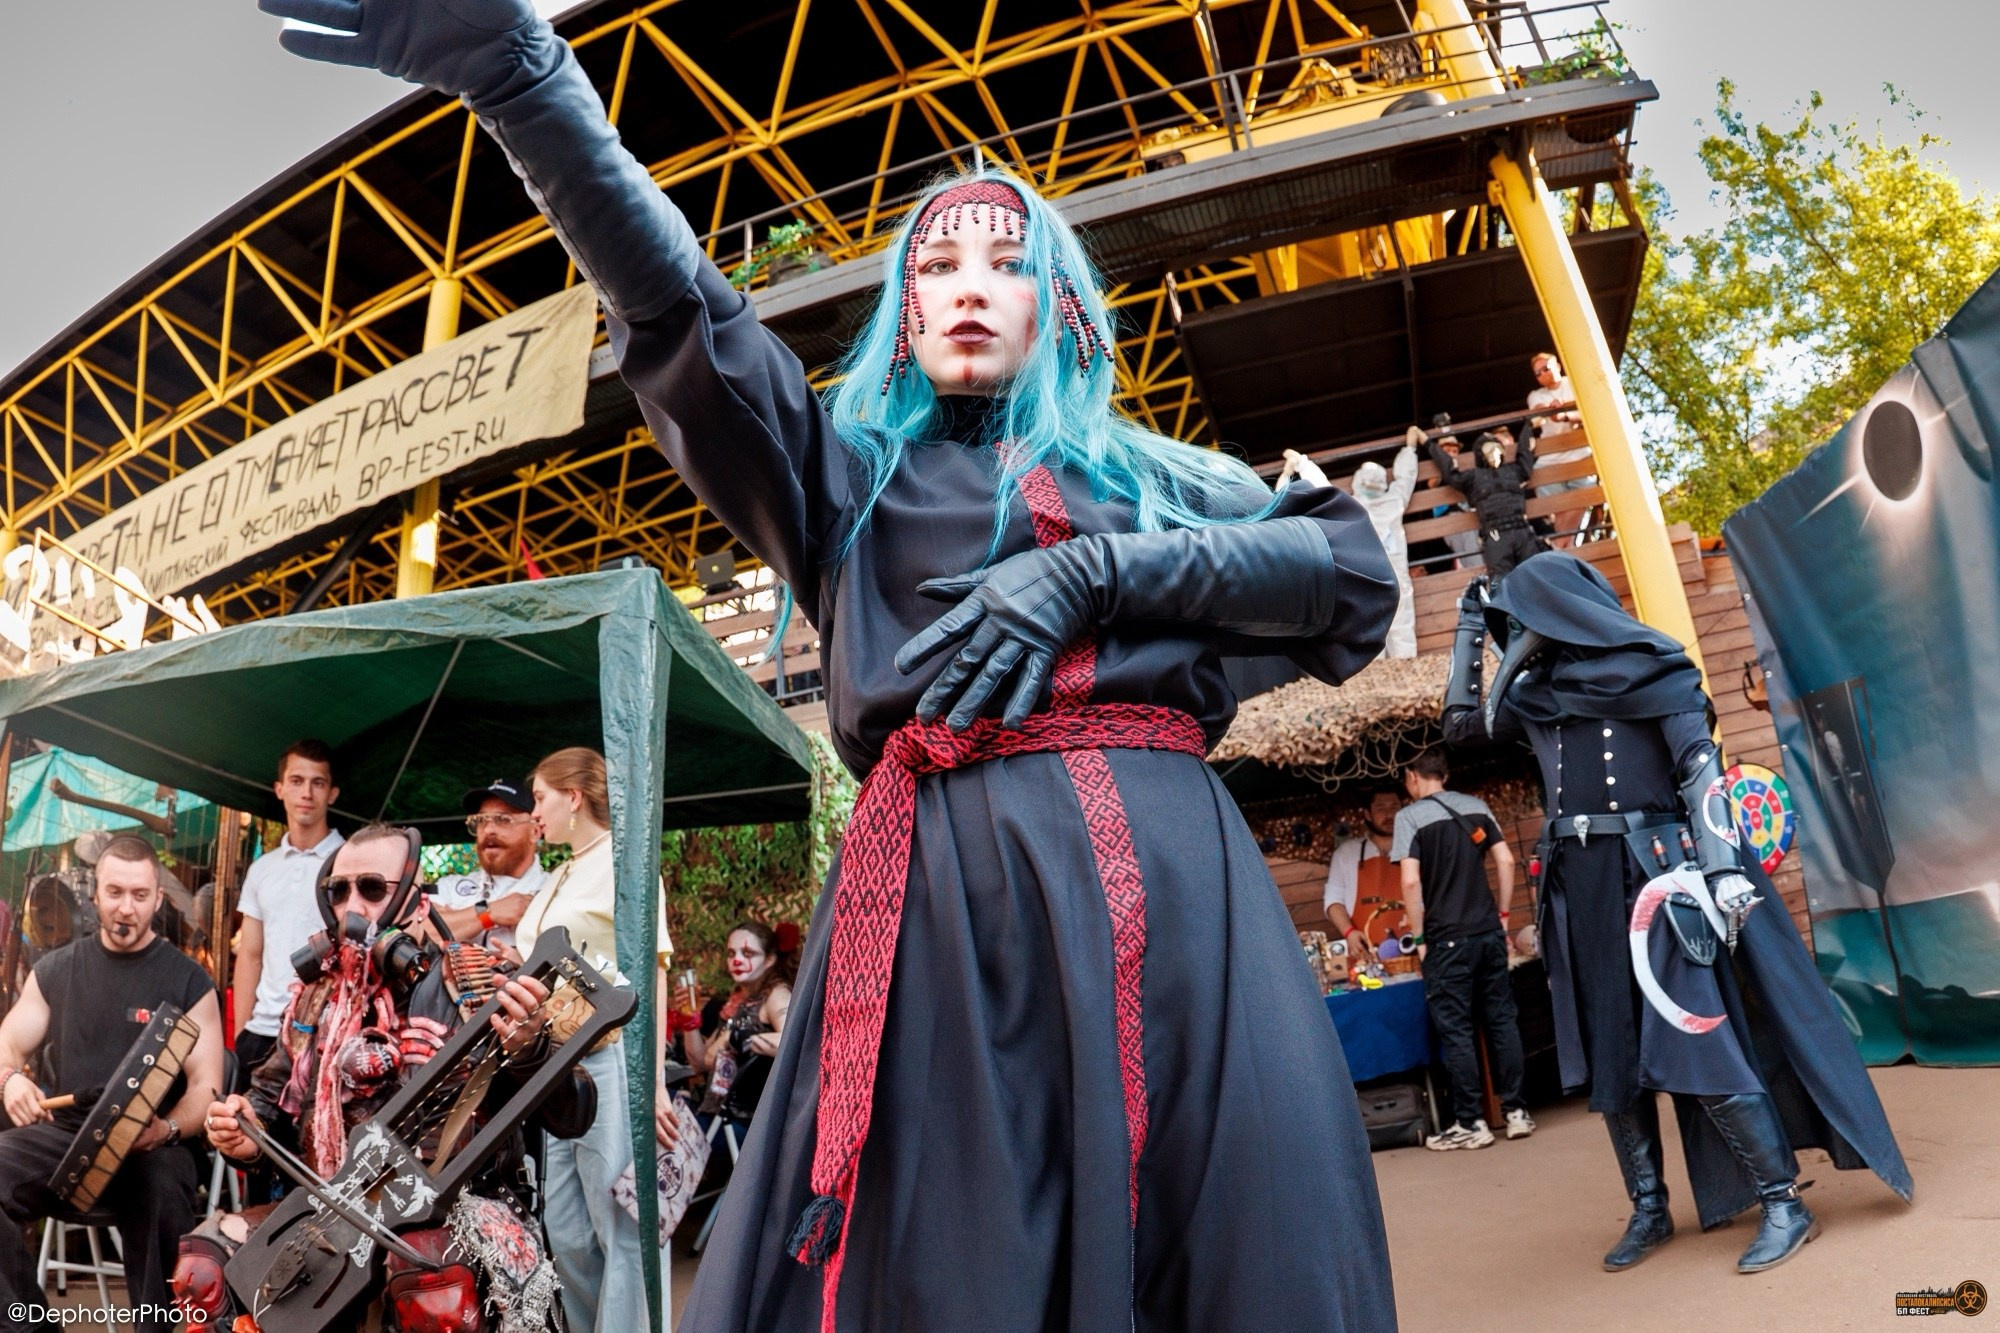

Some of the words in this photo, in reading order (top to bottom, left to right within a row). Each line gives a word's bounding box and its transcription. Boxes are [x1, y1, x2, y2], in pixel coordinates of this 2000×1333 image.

[146, 484, 198, 561] НЕ
[199, 406, 361, 534] ОТМЕНЯЕТ
[356, 326, 550, 457] РАССВЕТ
[240, 484, 342, 549] ФЕСТИВАЛЬ
[357, 416, 507, 501] BP-FEST.RU
